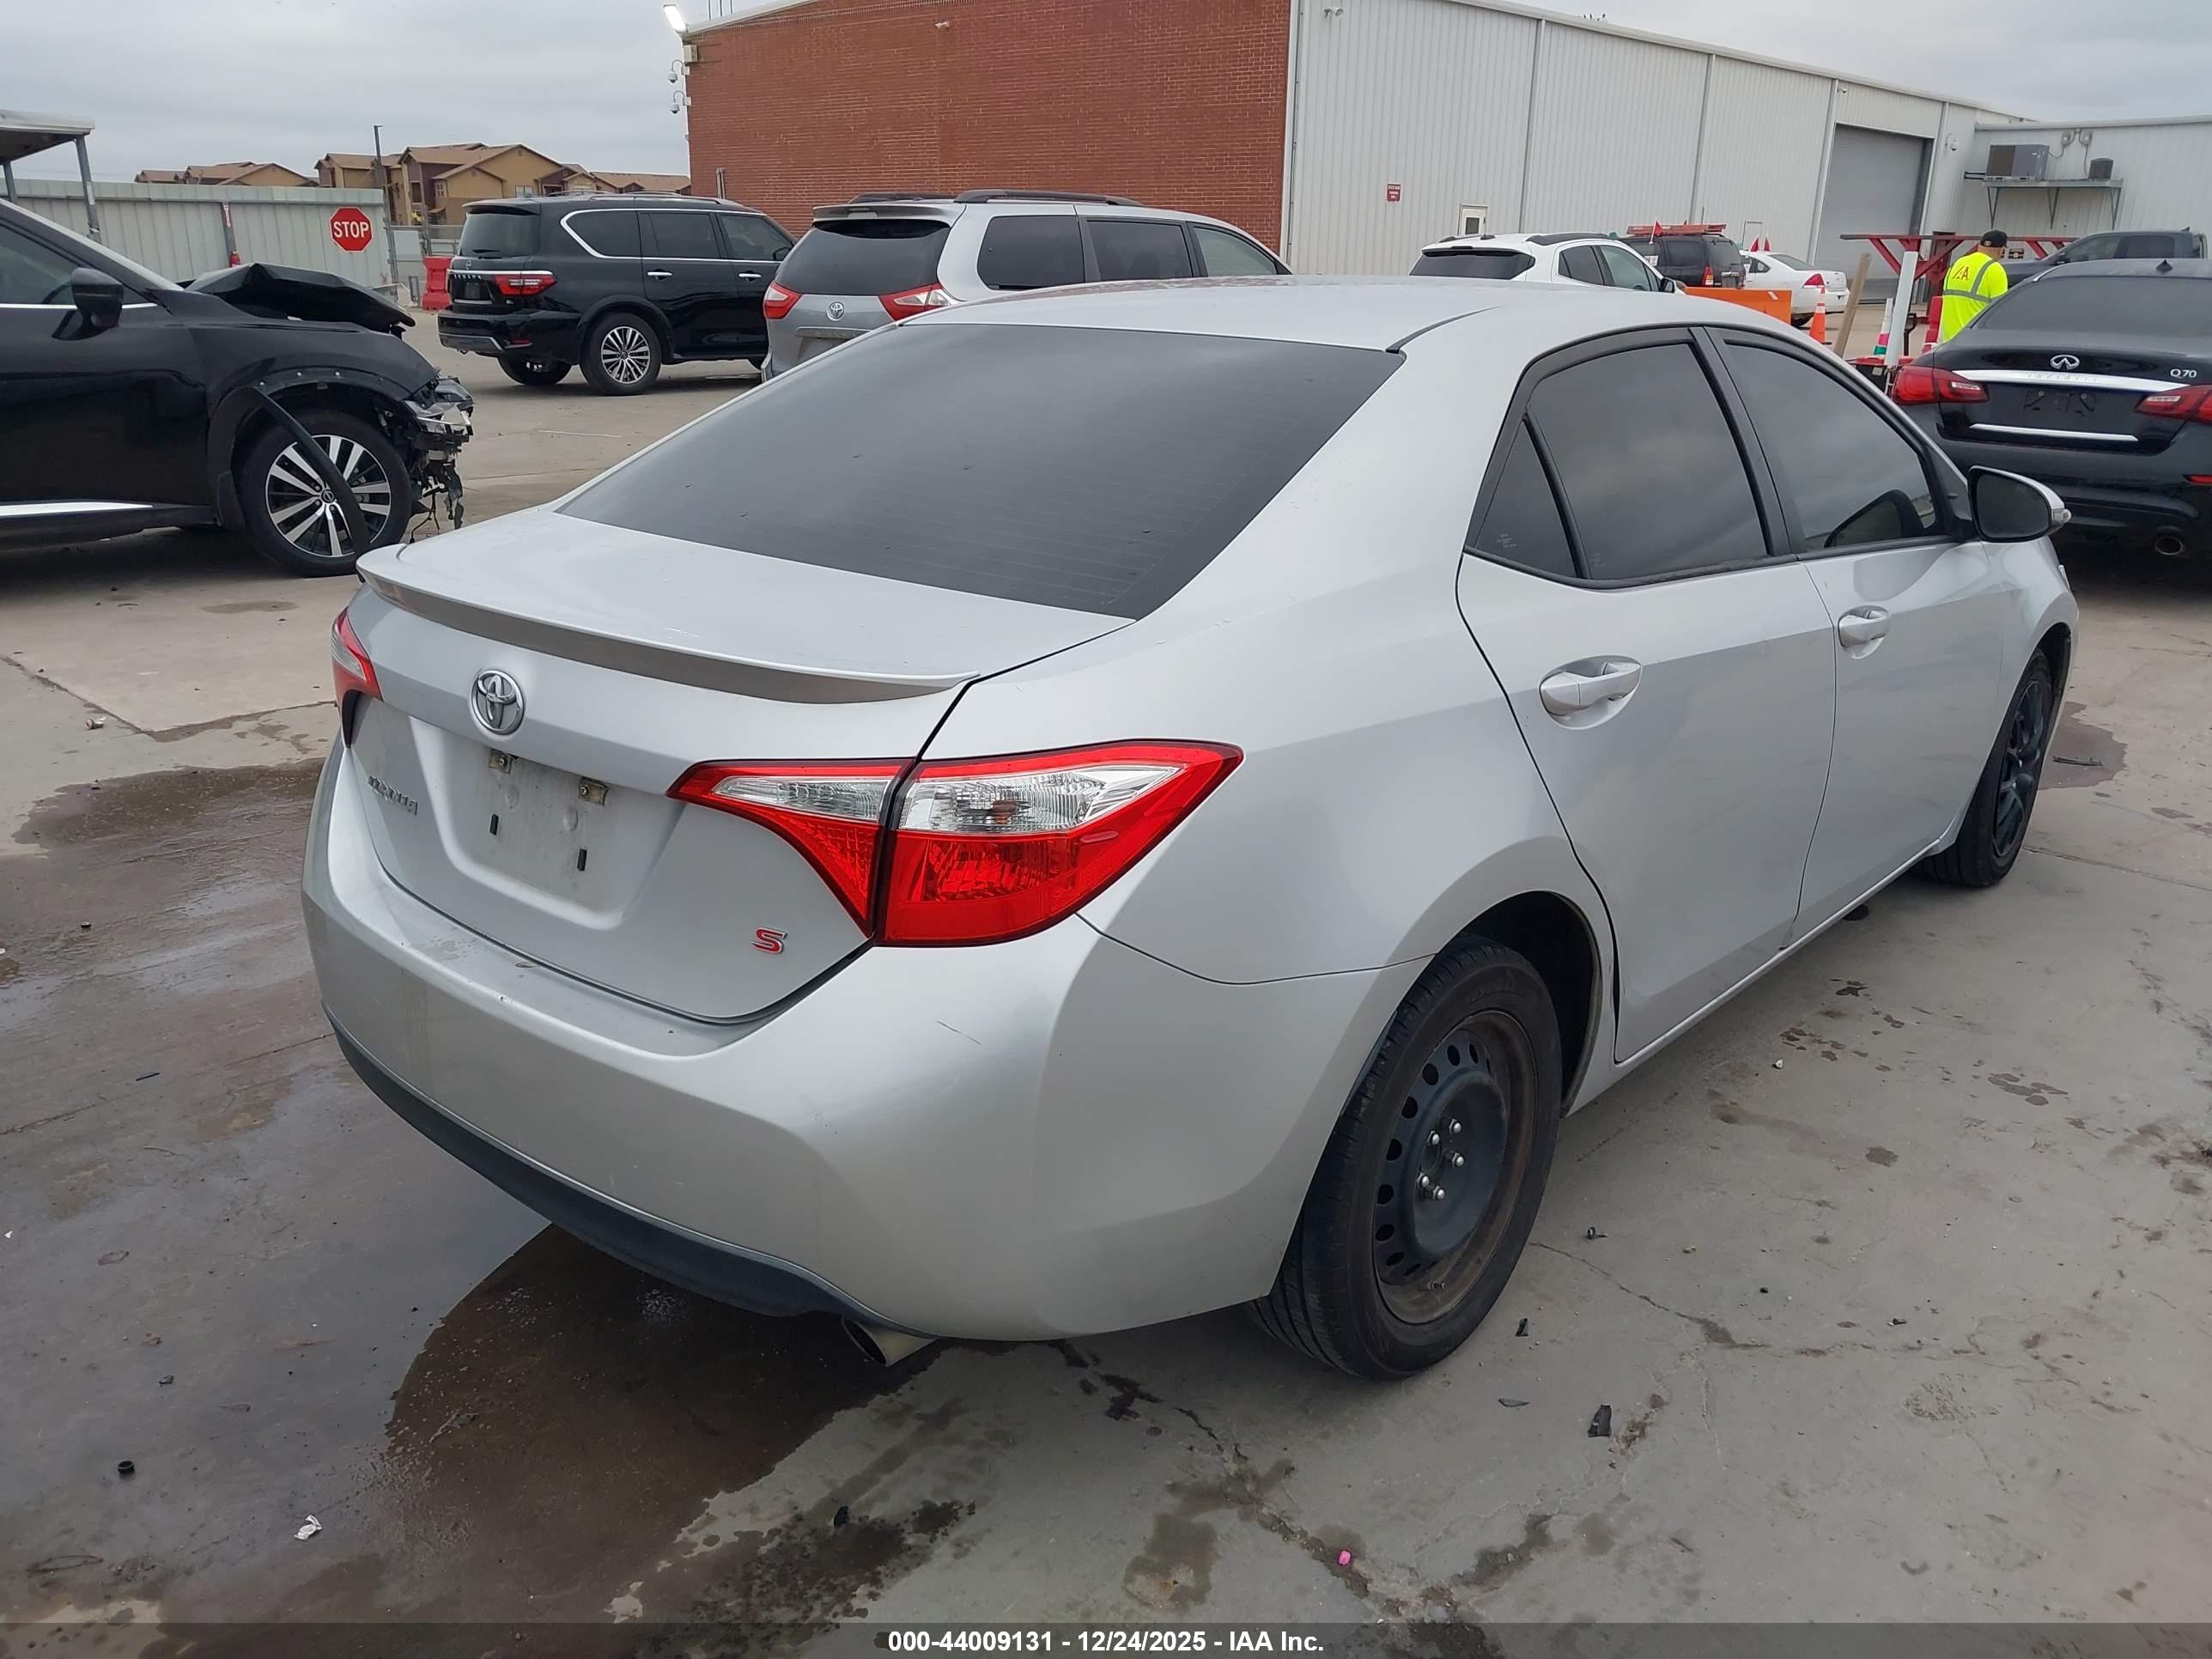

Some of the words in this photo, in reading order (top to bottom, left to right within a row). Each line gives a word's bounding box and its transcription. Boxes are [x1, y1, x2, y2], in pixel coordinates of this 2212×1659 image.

[334, 221, 369, 238] STOP
[2170, 368, 2197, 379] Q70
[750, 927, 788, 954] S
